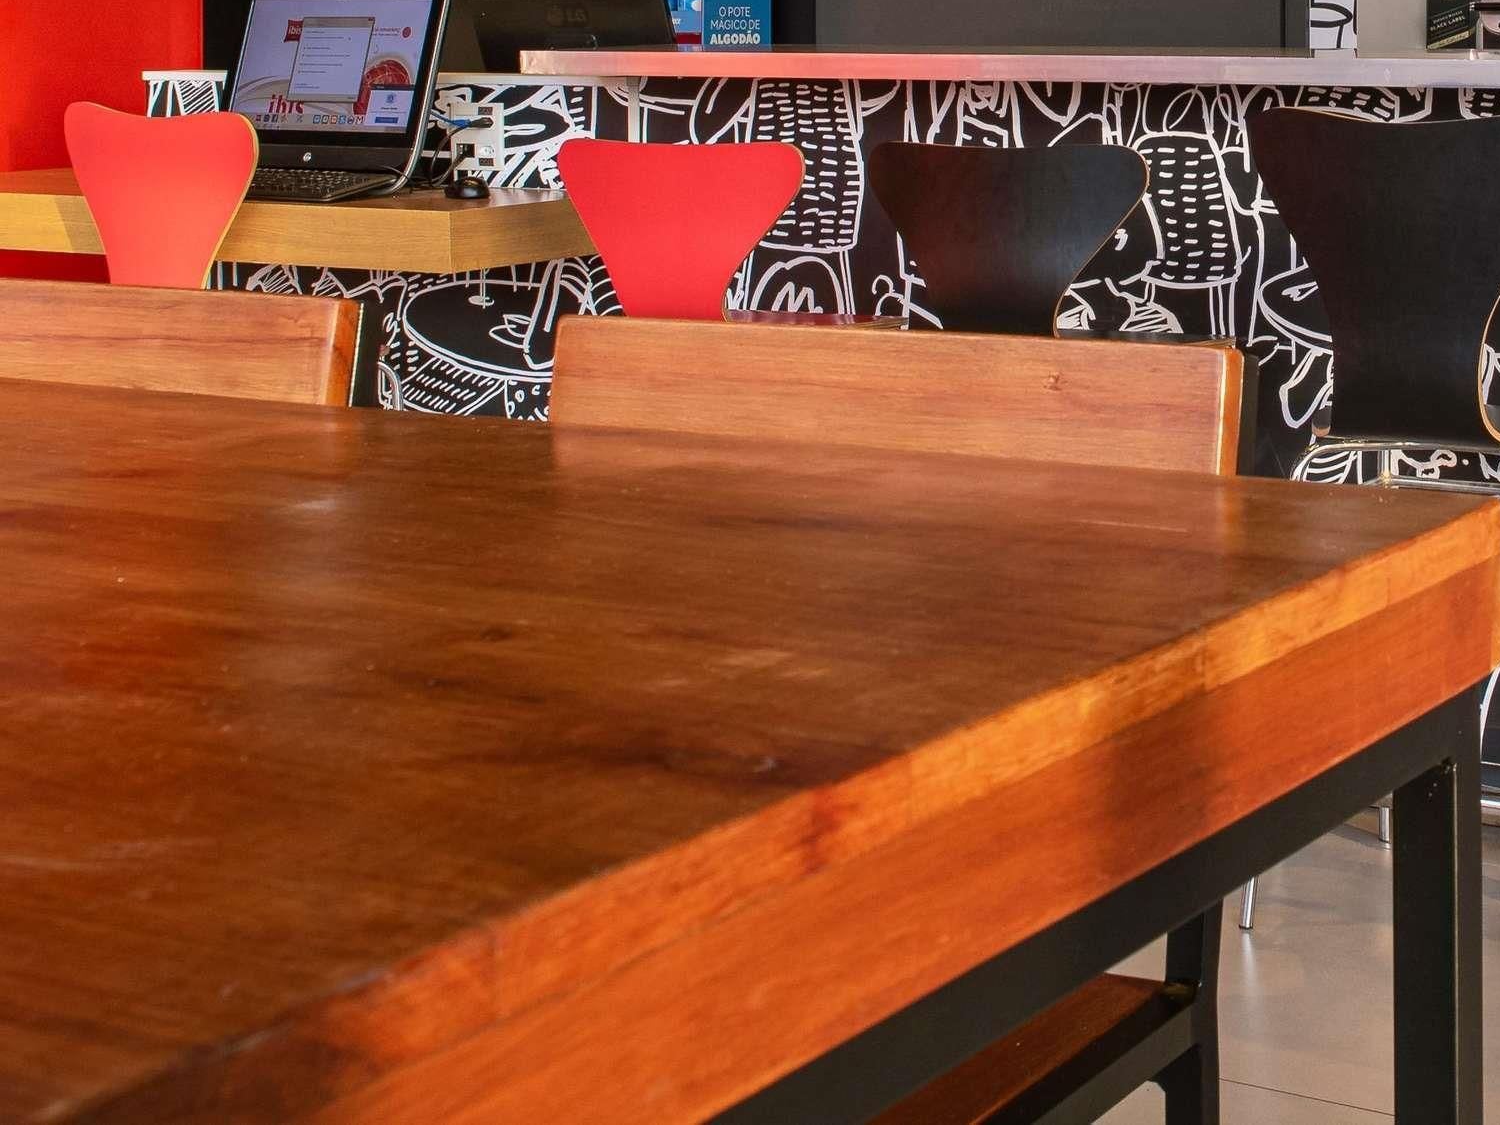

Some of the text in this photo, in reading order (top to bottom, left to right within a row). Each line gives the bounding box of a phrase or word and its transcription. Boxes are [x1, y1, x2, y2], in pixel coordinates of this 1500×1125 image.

[719, 6, 751, 17] O POTE
[749, 19, 760, 30] DE
[709, 30, 761, 45] ALGODÃO
